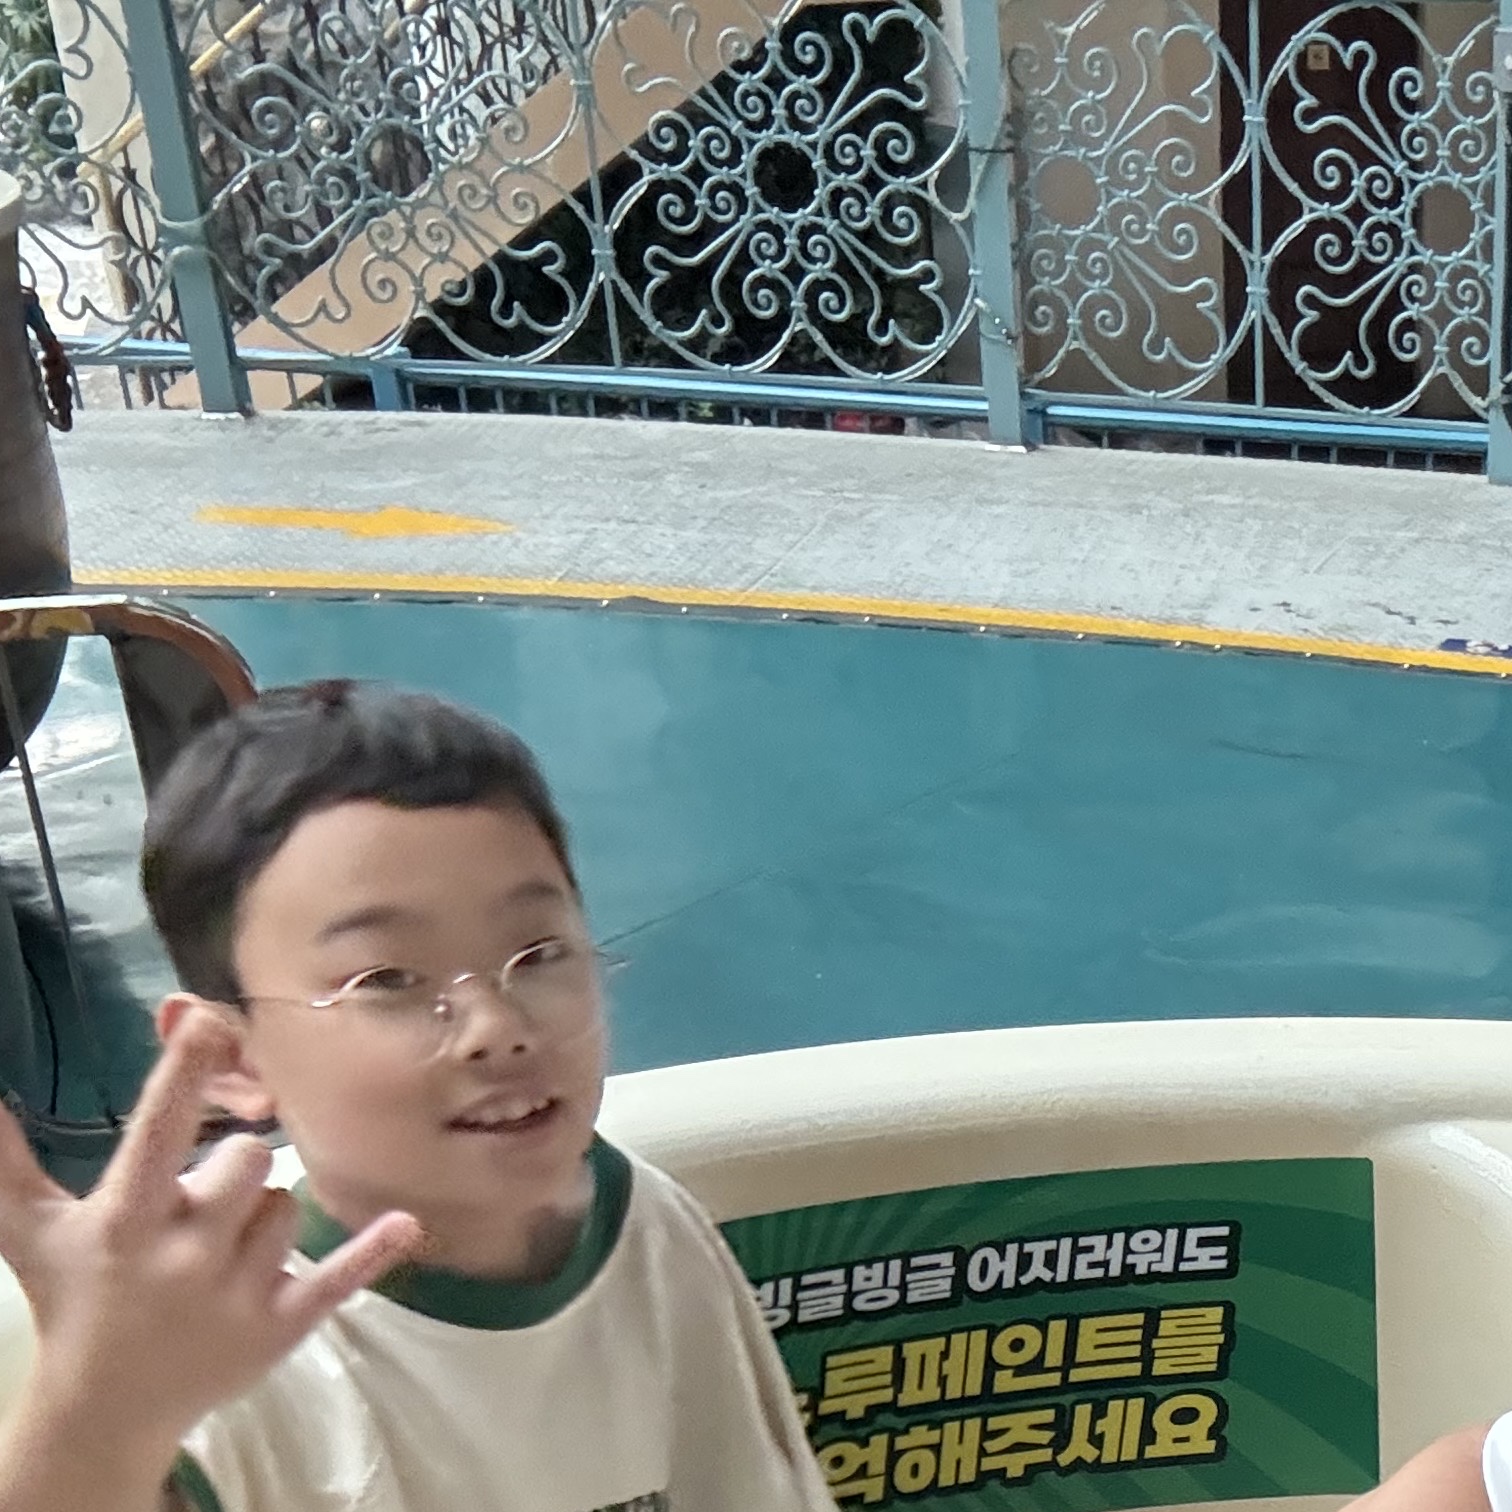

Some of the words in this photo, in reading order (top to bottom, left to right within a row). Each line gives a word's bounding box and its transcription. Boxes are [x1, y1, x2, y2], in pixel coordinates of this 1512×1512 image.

[756, 1251, 956, 1330] 빙글빙글
[967, 1226, 1230, 1292] 어지러워도
[797, 1306, 1226, 1426] 루페인트를
[818, 1394, 1218, 1503] 억해주세요
